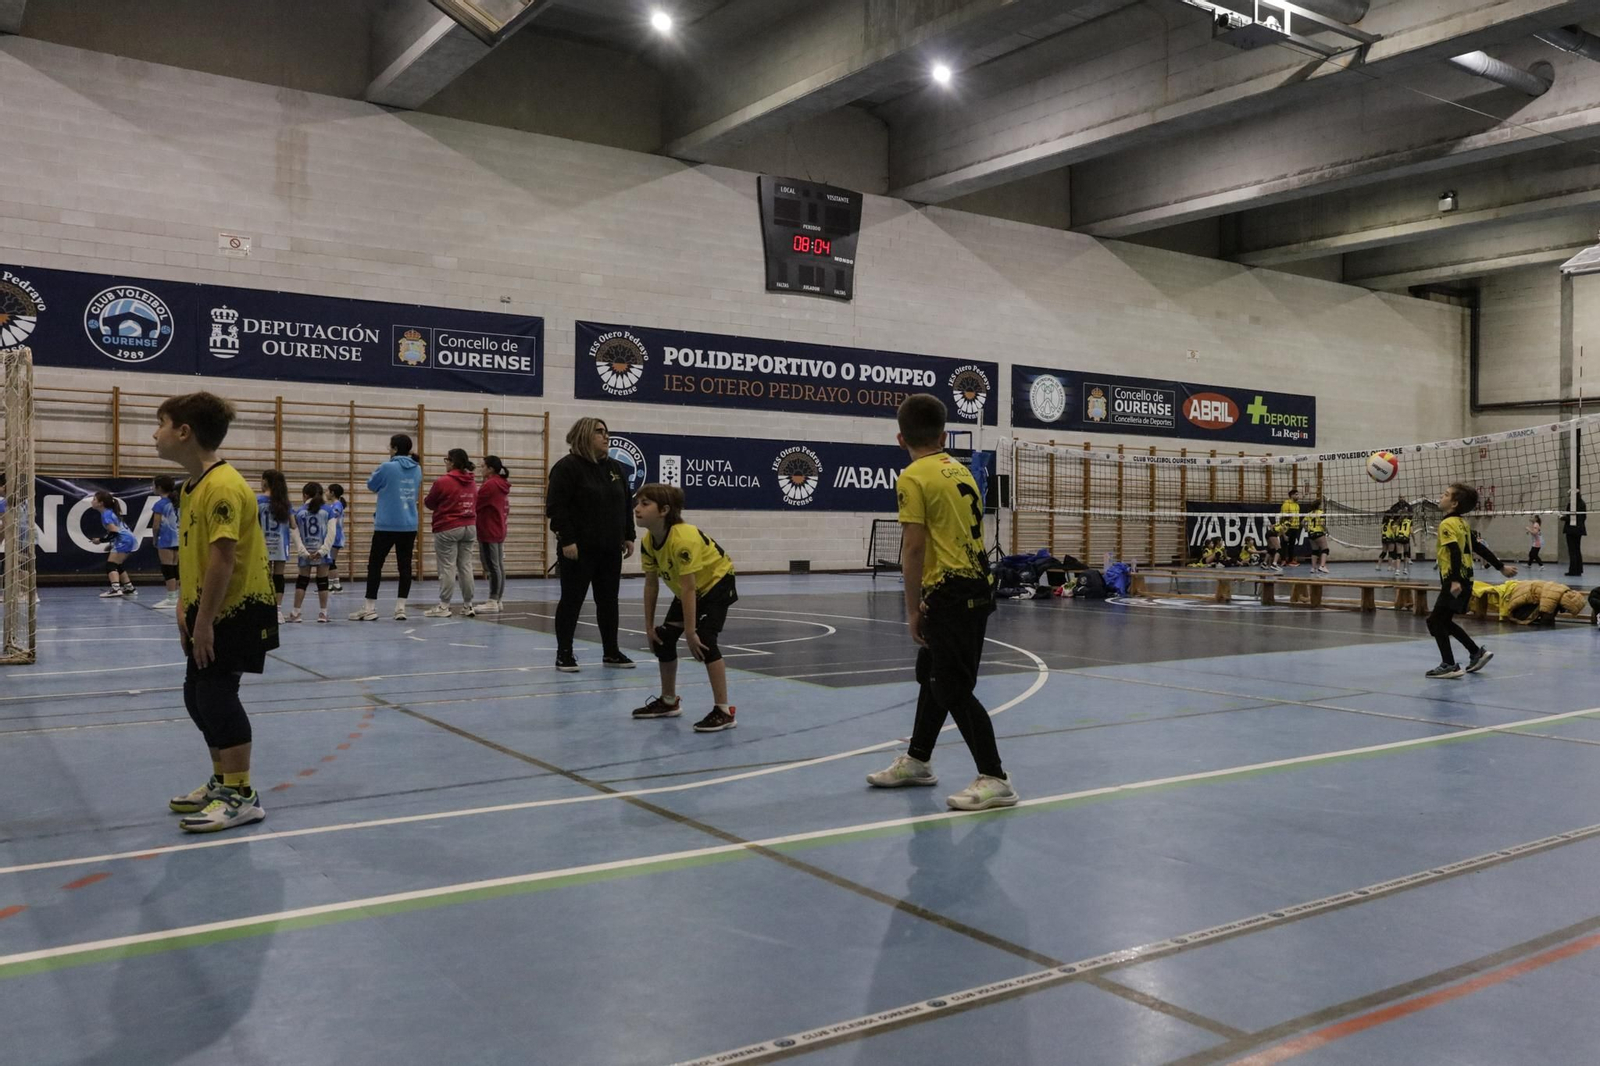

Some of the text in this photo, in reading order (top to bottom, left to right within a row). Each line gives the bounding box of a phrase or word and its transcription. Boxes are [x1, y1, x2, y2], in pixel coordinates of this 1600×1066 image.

[780, 186, 796, 194] LOCAL
[827, 194, 850, 204] VISITANTE
[793, 235, 831, 254] 08:04
[2, 271, 46, 311] Pedrayo
[91, 289, 168, 320] CLUB VOLEIBOL
[242, 317, 380, 344] DEPUTACIÓN
[102, 336, 158, 348] OURENSE
[438, 334, 519, 353] Concello de
[589, 330, 650, 362] IES Otero Pedrayo
[116, 349, 144, 360] 1989
[262, 340, 362, 362] OURENSE
[438, 351, 531, 371] OURENSE
[664, 346, 936, 388] POLIDEPORTIVO O POMPEO
[973, 365, 990, 390] Pedrayo
[602, 382, 638, 396] Ourense
[664, 374, 695, 392] IES
[700, 377, 764, 398] OTERO
[768, 382, 853, 404] PEDRAYO.
[1114, 388, 1164, 403] Concello de
[1114, 400, 1172, 416] OURENSE
[1189, 399, 1234, 424] ABRIL
[1150, 418, 1172, 426] Deportes
[1271, 428, 1282, 438] La
[772, 446, 824, 472] IES Otero Pedrayo
[1147, 456, 1172, 464] VOLEIBOL
[1336, 450, 1370, 460] VOLEIBOL
[686, 458, 733, 472] XUNTA
[686, 474, 760, 488] DE GALICIA
[782, 495, 814, 506] Ourense
[300, 516, 320, 538] 18
[802, 1006, 923, 1040] CLUB VOLEIBOL OURENSE
[716, 1046, 766, 1062] OURENSE
